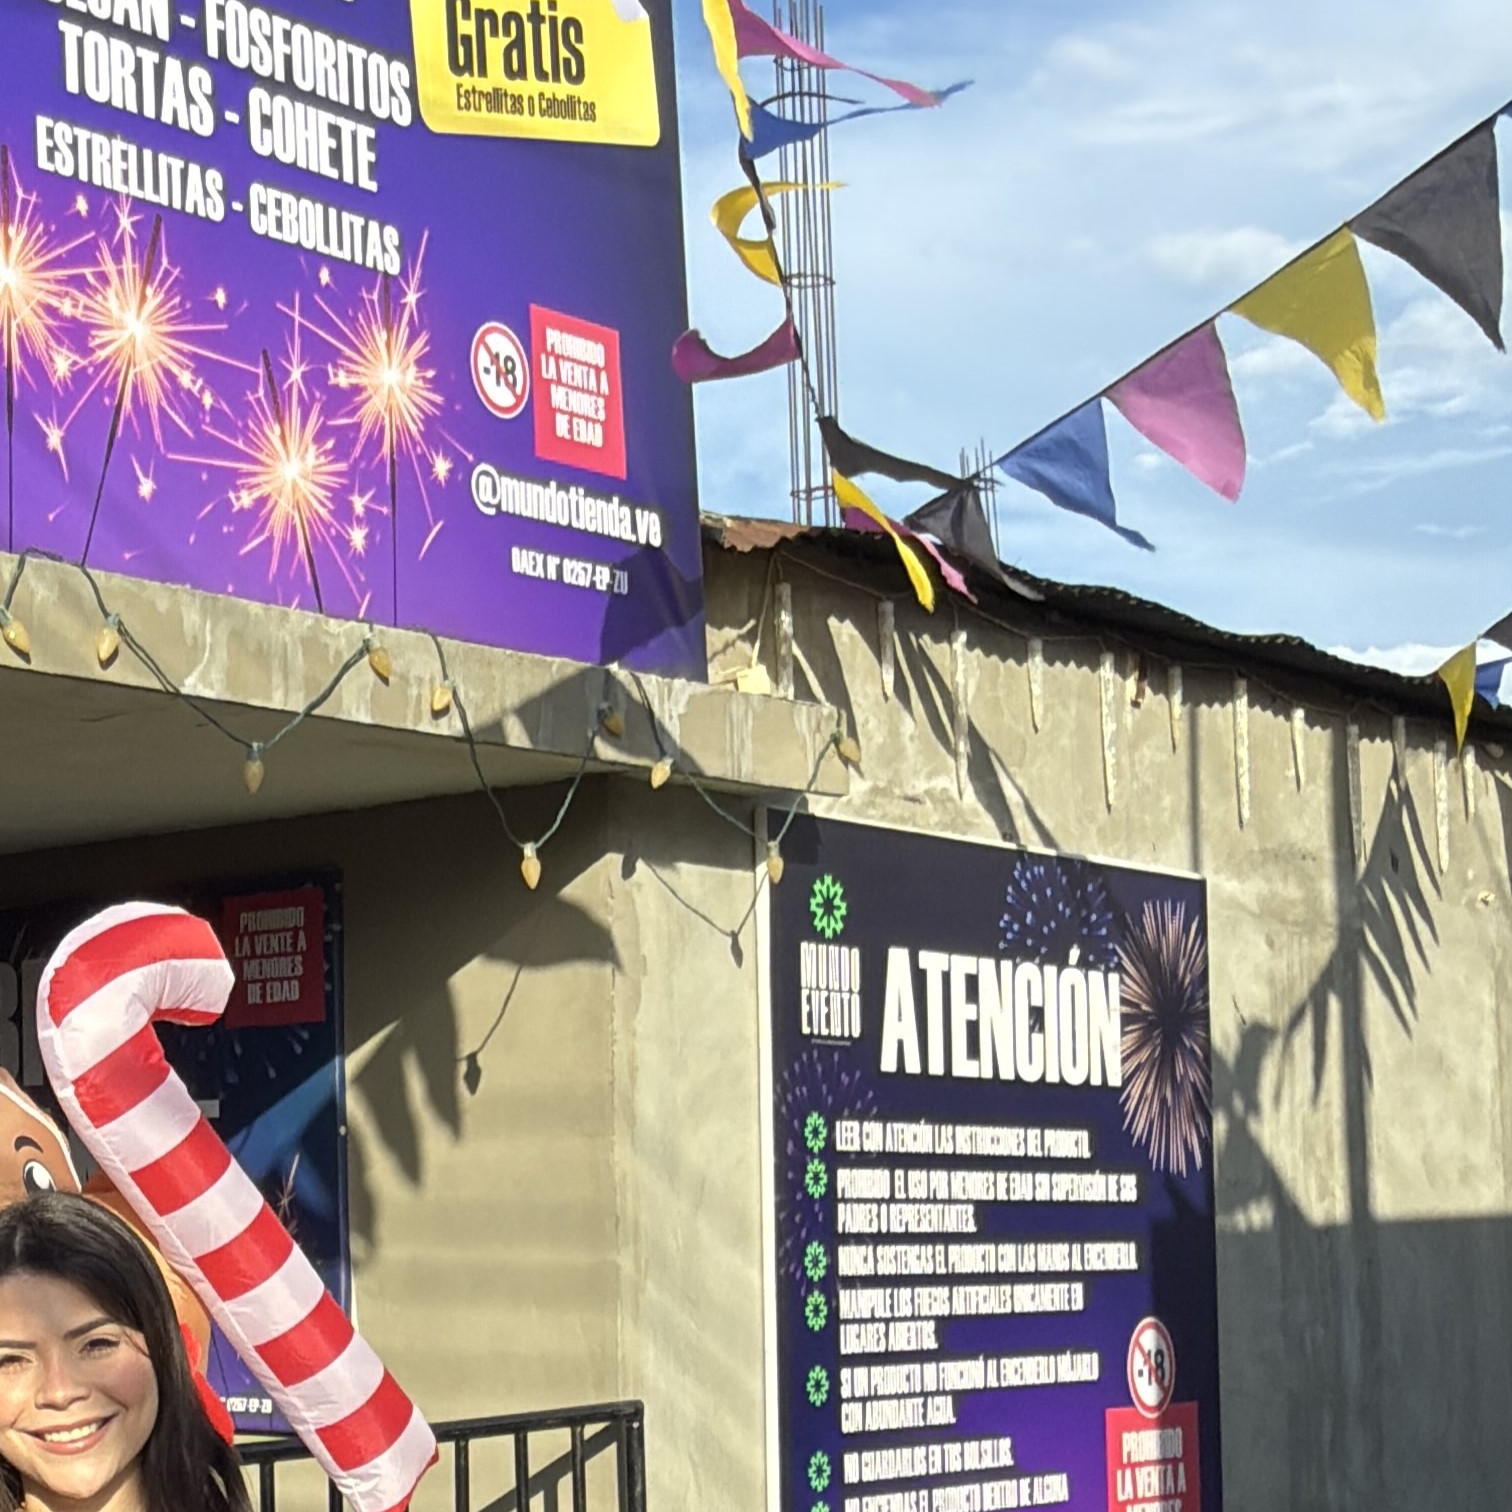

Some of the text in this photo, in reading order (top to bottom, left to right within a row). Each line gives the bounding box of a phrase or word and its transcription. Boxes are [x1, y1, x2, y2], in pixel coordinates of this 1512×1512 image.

[58, 20, 378, 192] TORTAS COHETE
[456, 83, 597, 123] Estrellitas o Cebollitas
[36, 115, 402, 276] ESTRELLITAS CEBOLLITAS
[545, 327, 606, 368] PROHIBIDO
[540, 353, 610, 396] LA VENTA A
[550, 384, 606, 422] MENORES
[555, 412, 604, 448] DE EDAD
[471, 462, 662, 548] @mundotienda.ve
[235, 935, 251, 958] LA
[297, 929, 307, 953] A
[243, 954, 304, 981] MENORES
[800, 941, 860, 993] MUNDO
[247, 979, 300, 1004] DE EDAD
[801, 988, 861, 1038] EVENTO
[880, 944, 1122, 1087] ATENCIÓN
[838, 1204, 878, 1233] PADRES
[880, 1205, 888, 1233] O
[840, 1323, 886, 1355] LUGARES
[841, 1402, 862, 1434] CON
[865, 1397, 924, 1431] ABUNDANTE
[844, 1452, 859, 1484] NO
[929, 1444, 942, 1475] EN
[944, 1442, 961, 1473] TUS
[1116, 1462, 1187, 1503] LA VENTA A
